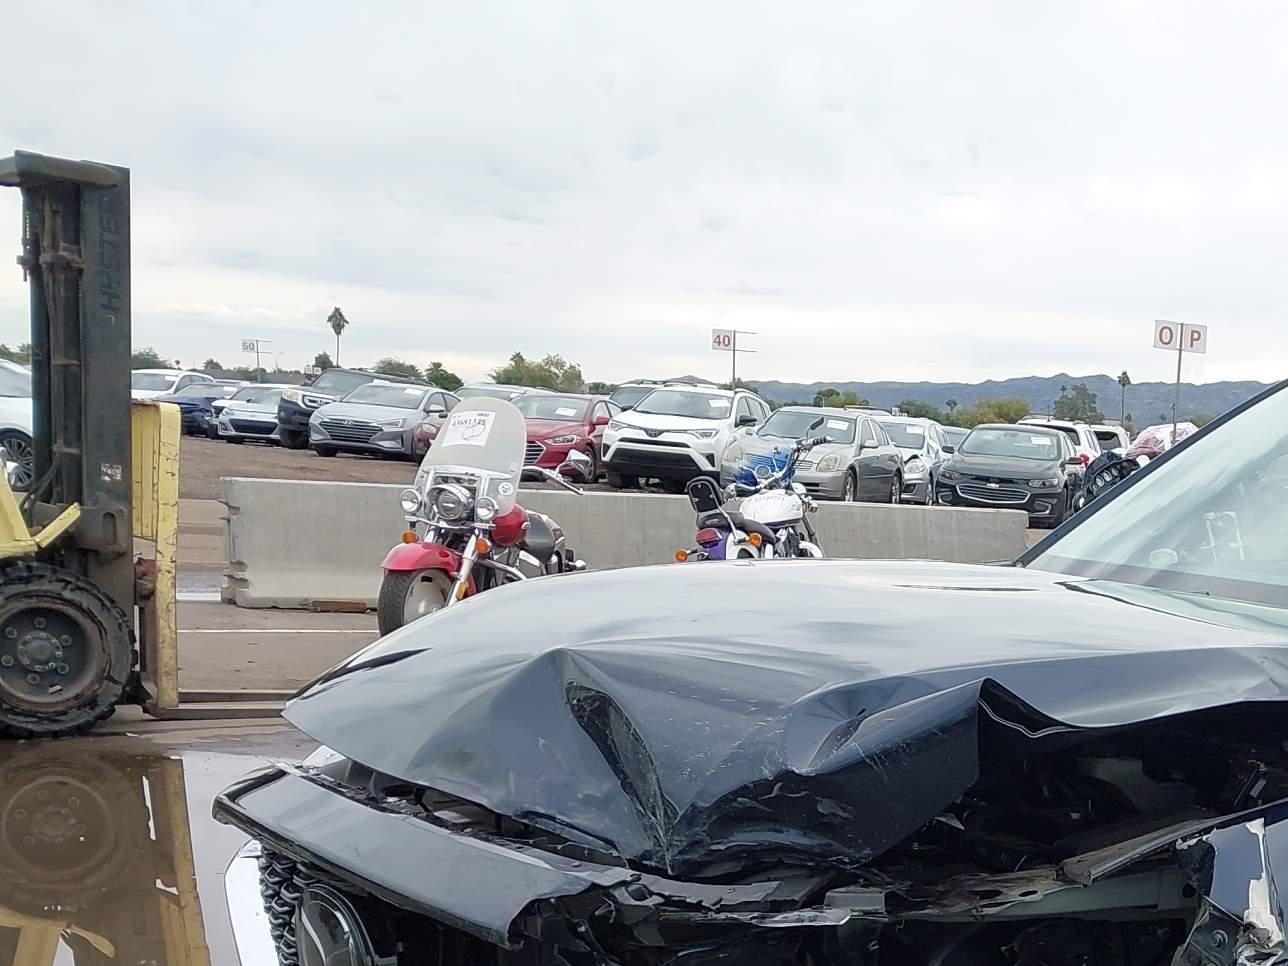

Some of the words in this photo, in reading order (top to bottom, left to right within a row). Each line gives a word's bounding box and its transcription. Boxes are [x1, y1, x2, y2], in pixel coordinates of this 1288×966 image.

[713, 334, 731, 347] 40
[1158, 325, 1174, 346] O
[1189, 329, 1202, 348] P
[242, 342, 255, 351] 50
